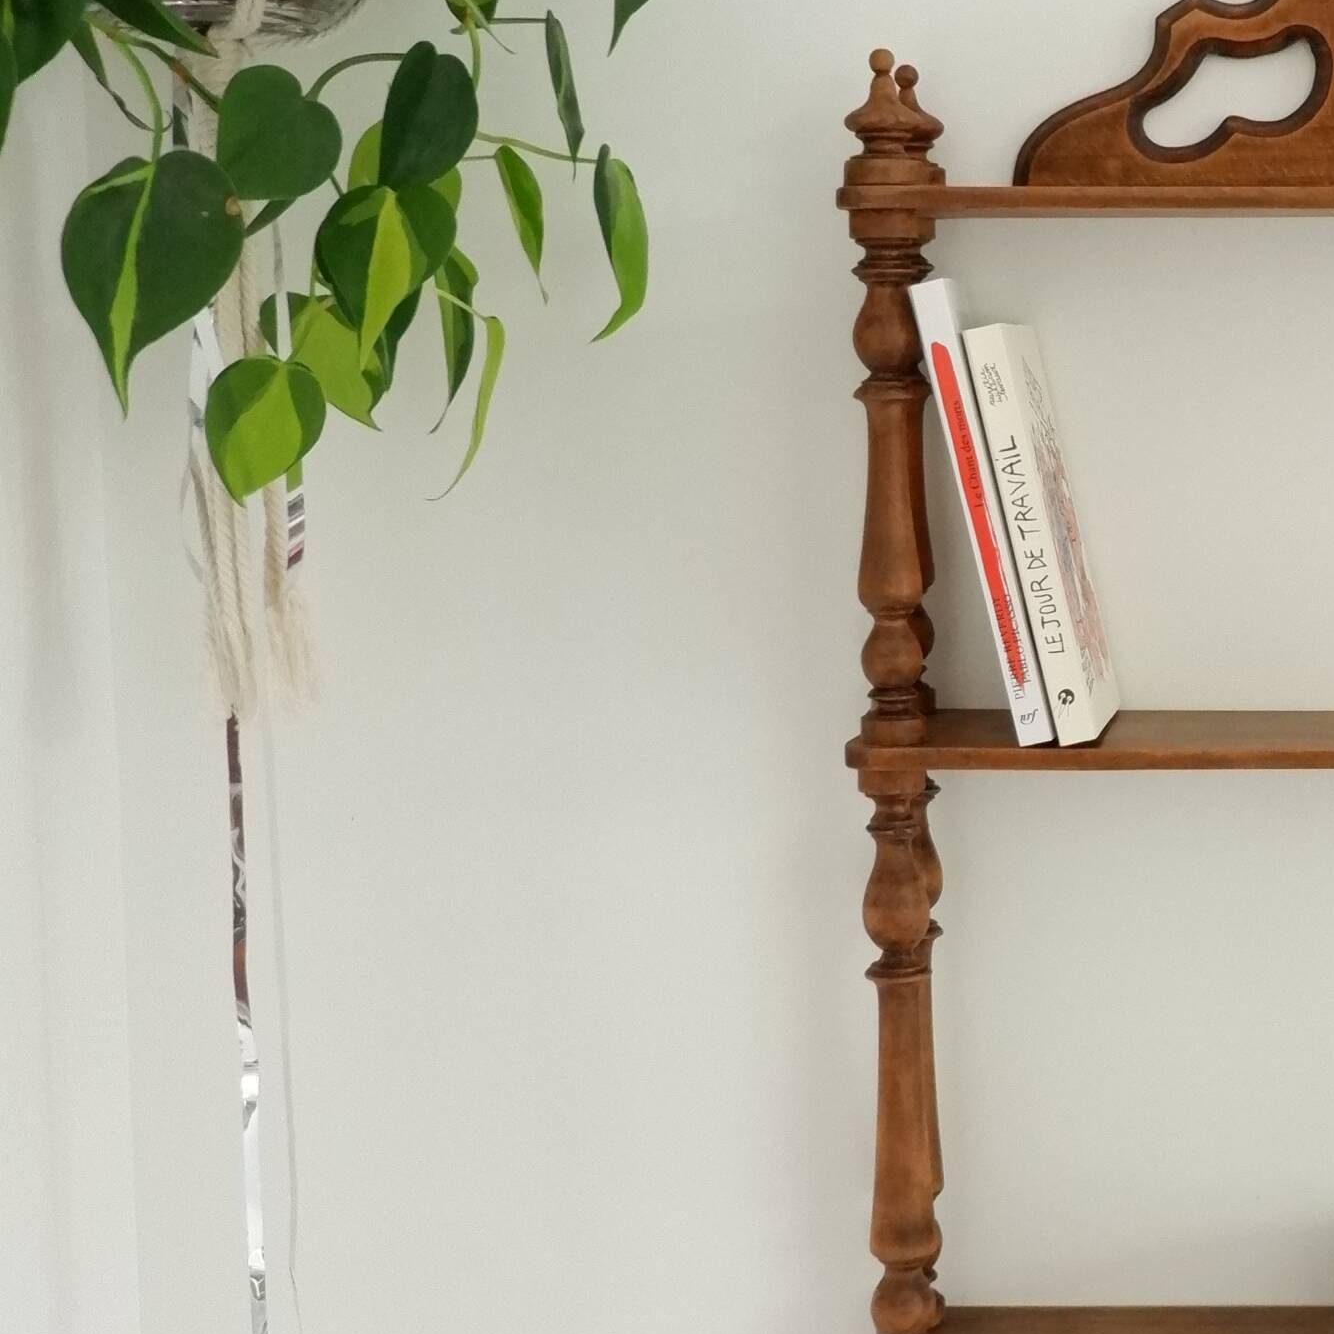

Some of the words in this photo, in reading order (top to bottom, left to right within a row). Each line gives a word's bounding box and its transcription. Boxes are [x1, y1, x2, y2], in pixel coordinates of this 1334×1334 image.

[960, 434, 972, 452] des
[966, 455, 980, 490] Chant
[973, 492, 984, 509] Le
[1024, 547, 1046, 571] DE
[1031, 574, 1061, 629] JOUR
[1046, 633, 1065, 654] LE
